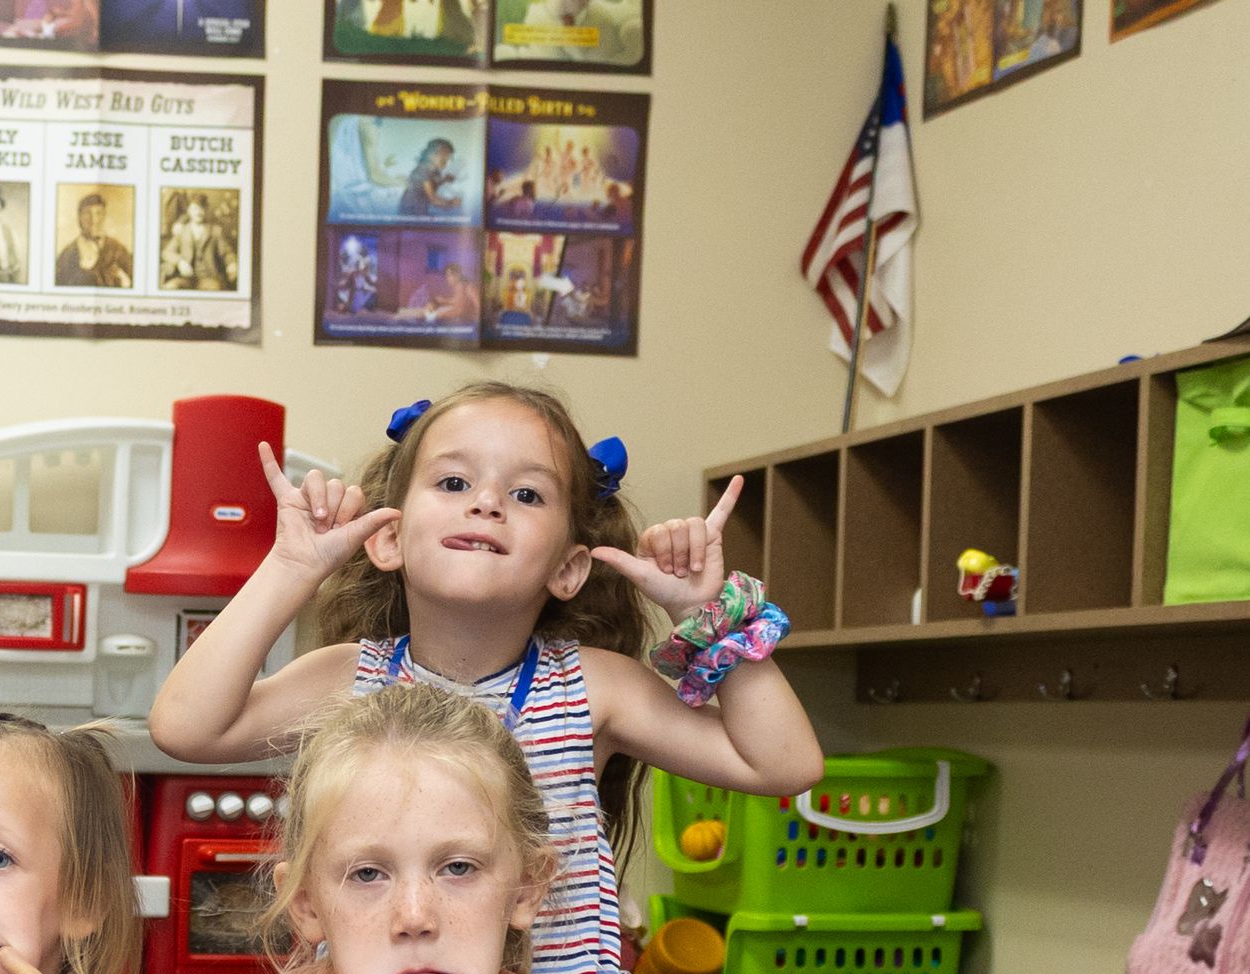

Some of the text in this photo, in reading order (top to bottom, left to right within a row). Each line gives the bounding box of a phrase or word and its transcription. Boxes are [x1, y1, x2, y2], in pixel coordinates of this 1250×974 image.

[1, 88, 196, 115] WILD WEST BAD GUYS
[69, 131, 124, 148] JESSE
[170, 135, 234, 152] BUTCH
[65, 153, 128, 171] JAMES
[160, 157, 242, 175] CASSIDY
[25, 302, 58, 314] person
